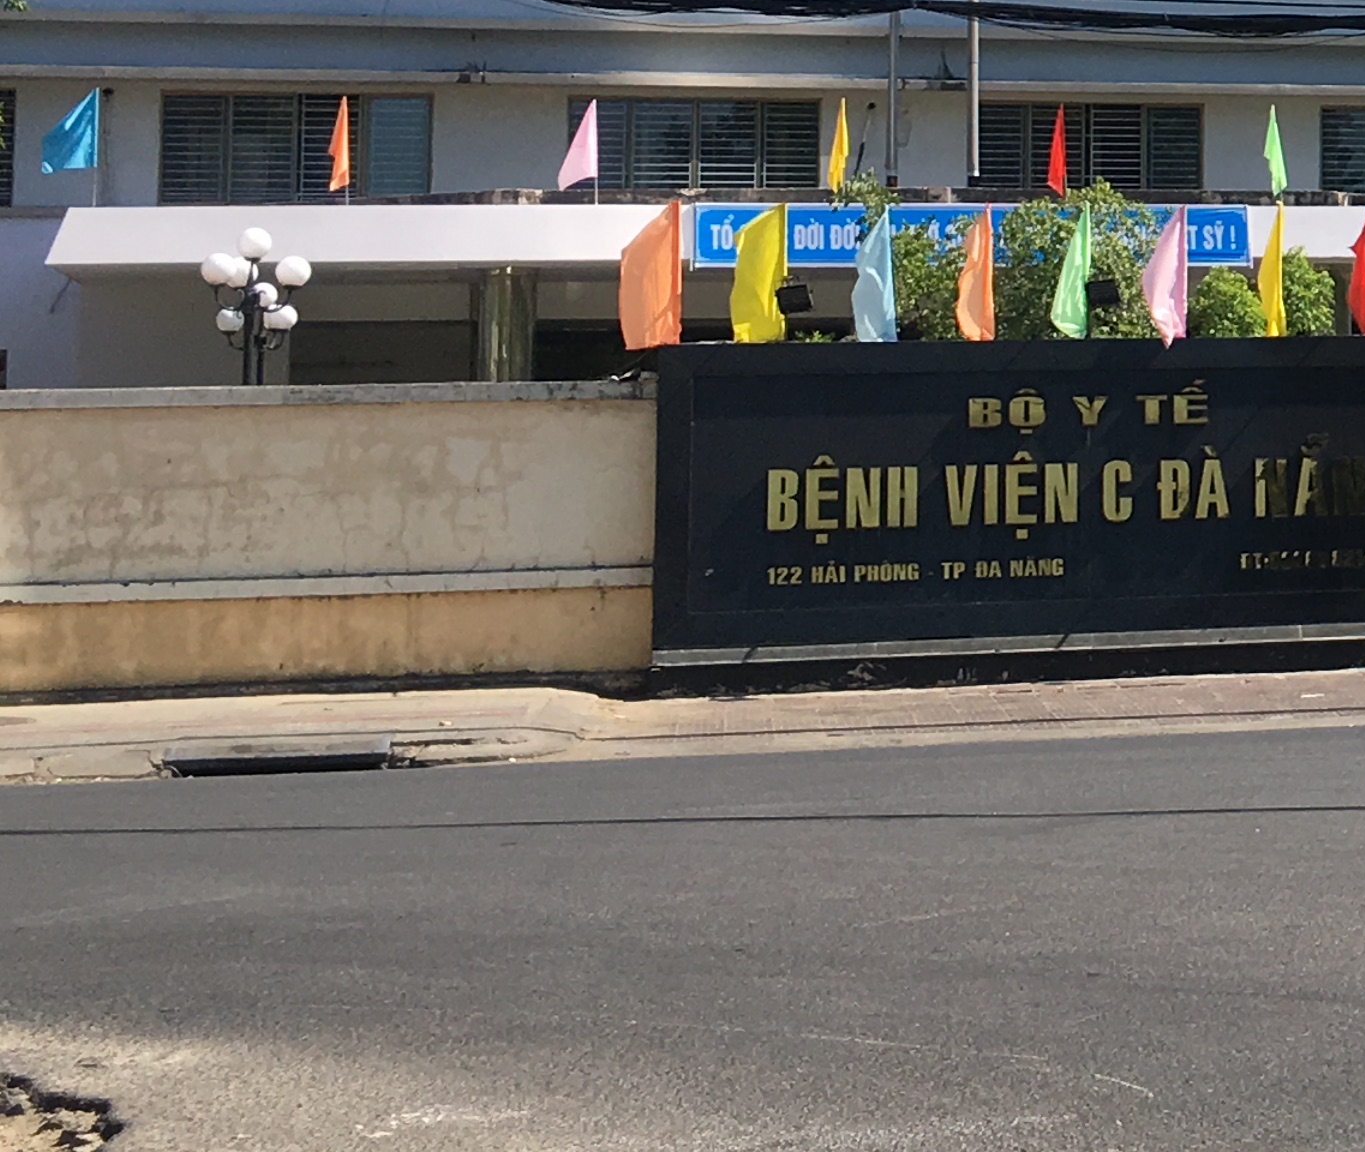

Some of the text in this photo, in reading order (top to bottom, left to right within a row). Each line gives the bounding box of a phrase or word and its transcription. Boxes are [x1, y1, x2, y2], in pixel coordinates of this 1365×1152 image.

[793, 218, 824, 250] ĐỜI
[1203, 222, 1225, 250] SỸ
[969, 379, 1209, 434] BỘ Y TẾ
[767, 454, 918, 544] BỆNH
[945, 450, 1079, 539] VIỆN
[1102, 460, 1133, 522] C
[1157, 445, 1230, 520] ĐÀ
[767, 566, 803, 586] 122
[941, 561, 966, 580] TP
